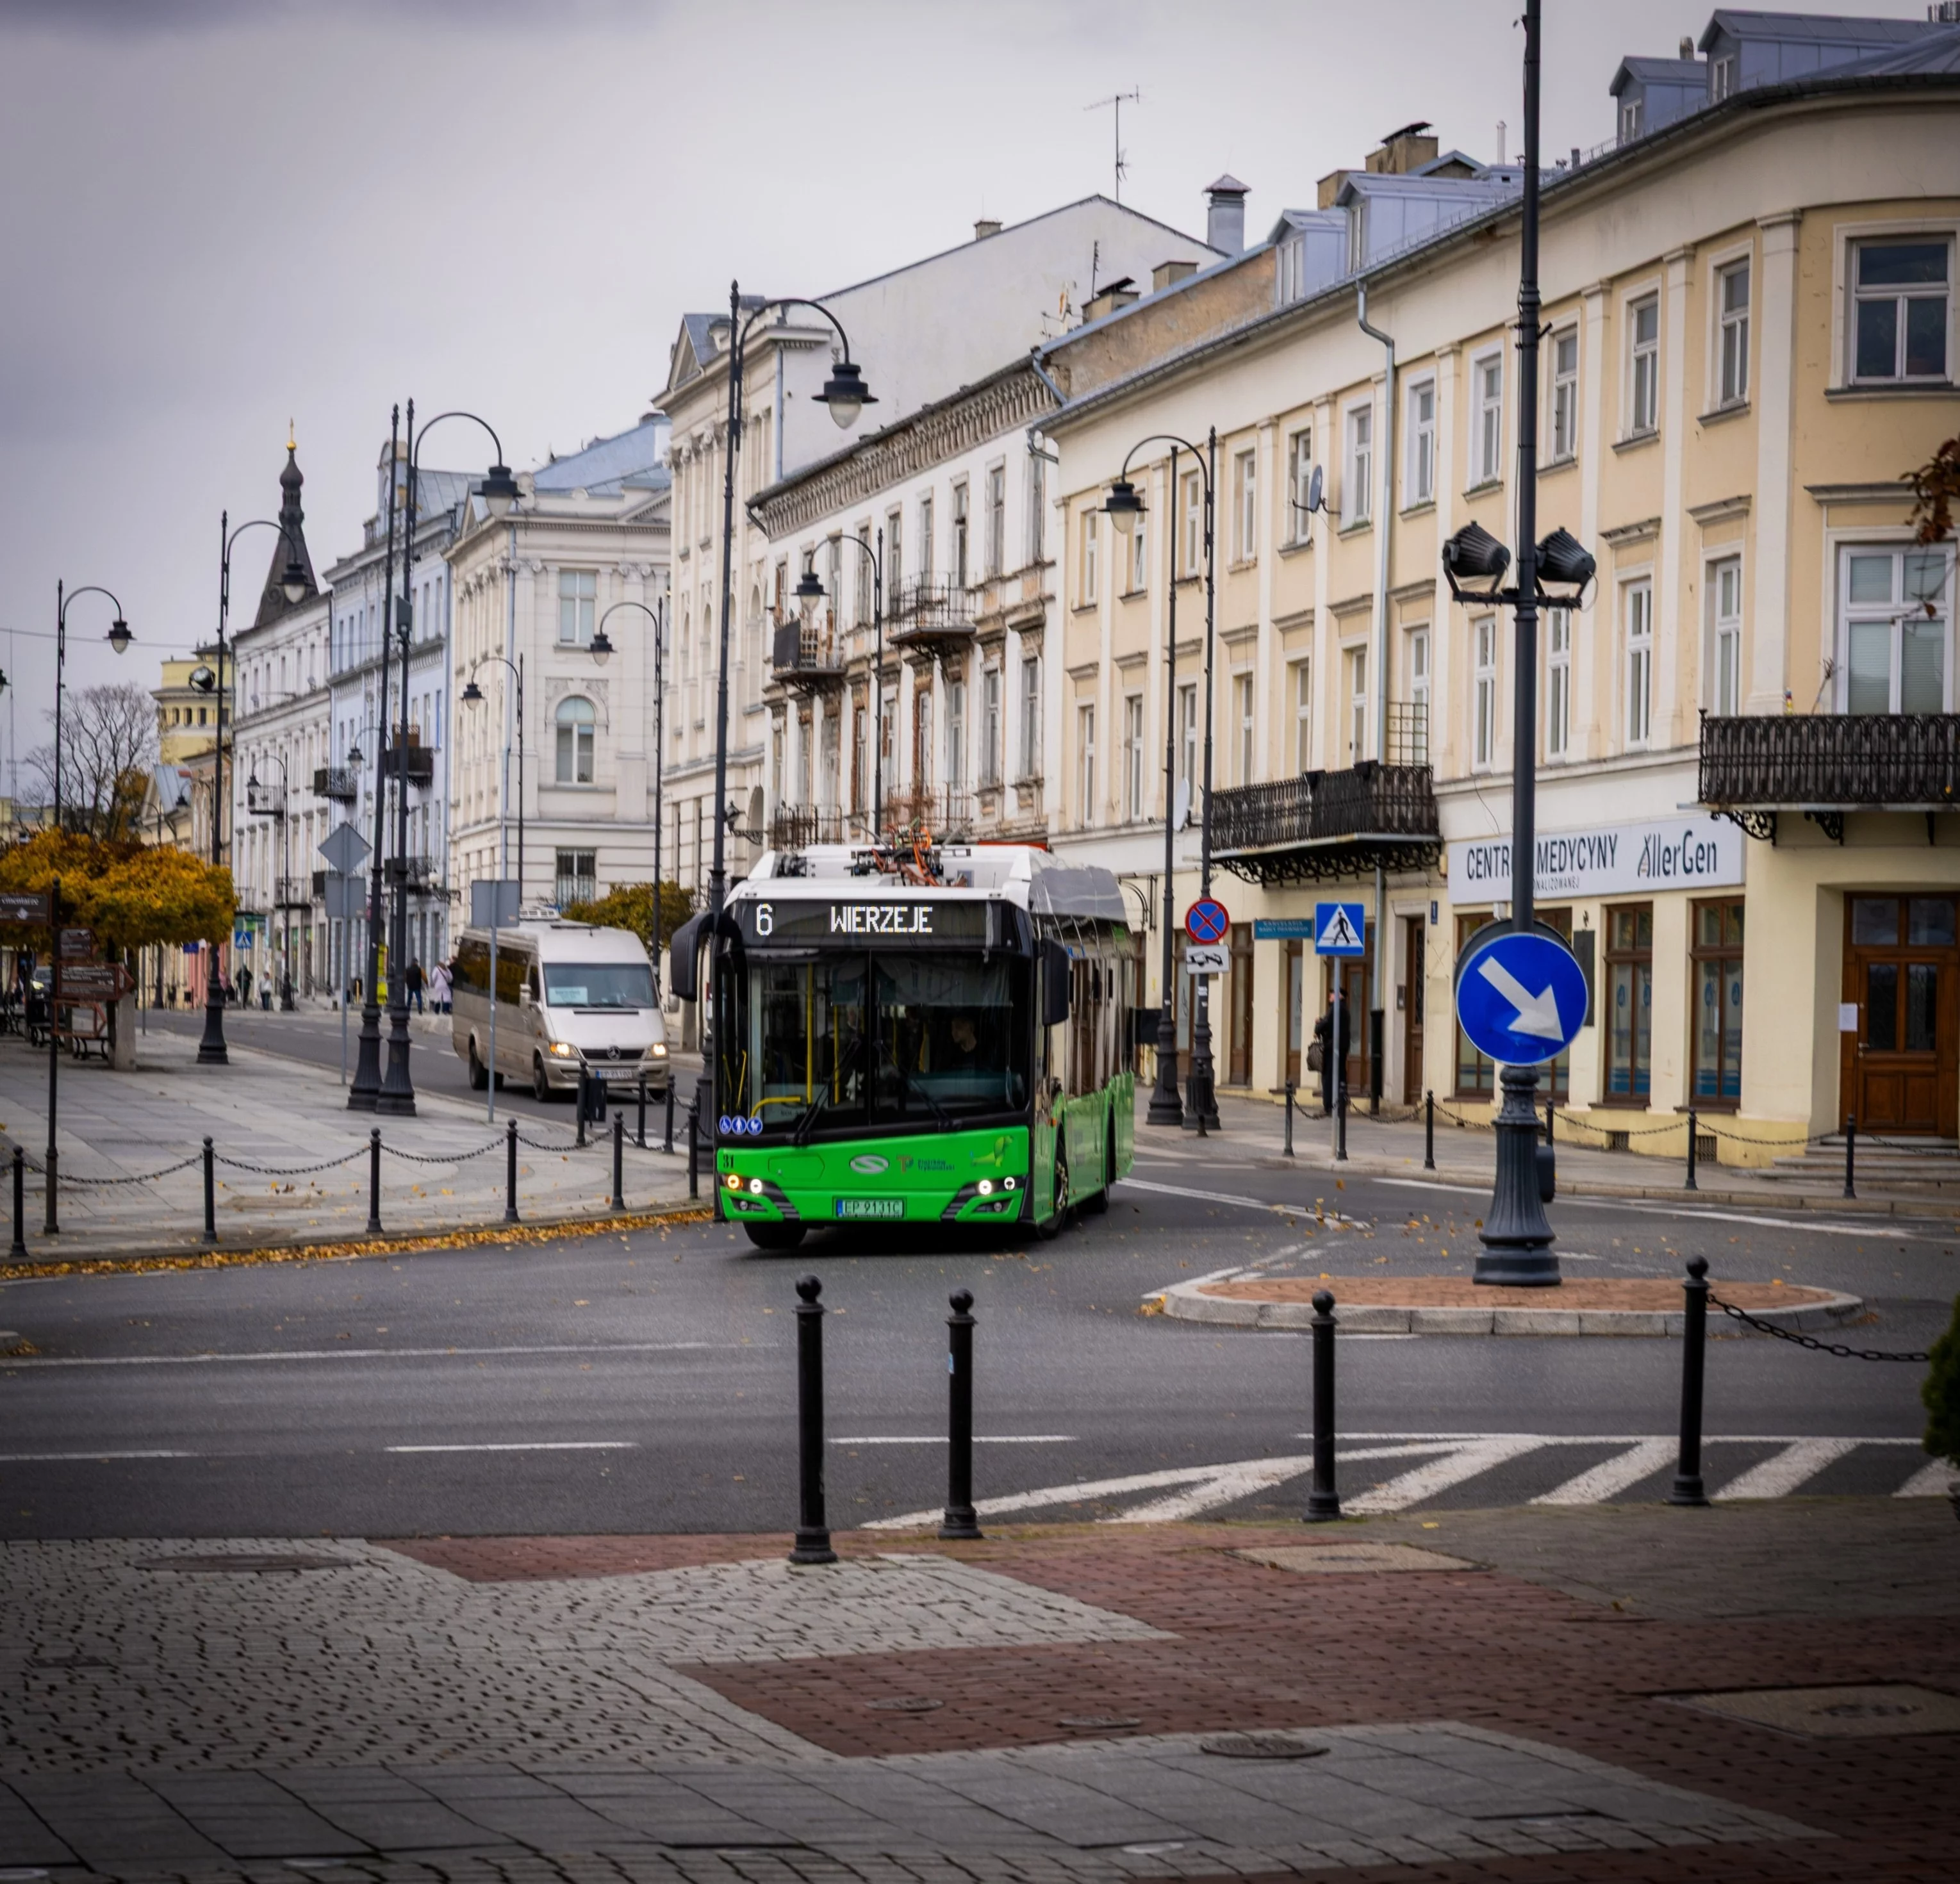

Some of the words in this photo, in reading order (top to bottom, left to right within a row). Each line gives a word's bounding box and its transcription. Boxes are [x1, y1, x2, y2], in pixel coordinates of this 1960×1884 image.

[1467, 844, 1513, 880] CENTR
[1537, 833, 1618, 875] MEDYCYNY
[1638, 829, 1717, 878] AllerGen
[757, 903, 773, 936] 6
[831, 906, 932, 933] WIERZEJE
[723, 1154, 734, 1169] 31
[845, 1200, 860, 1214] EP
[864, 1200, 900, 1215] 9131C
